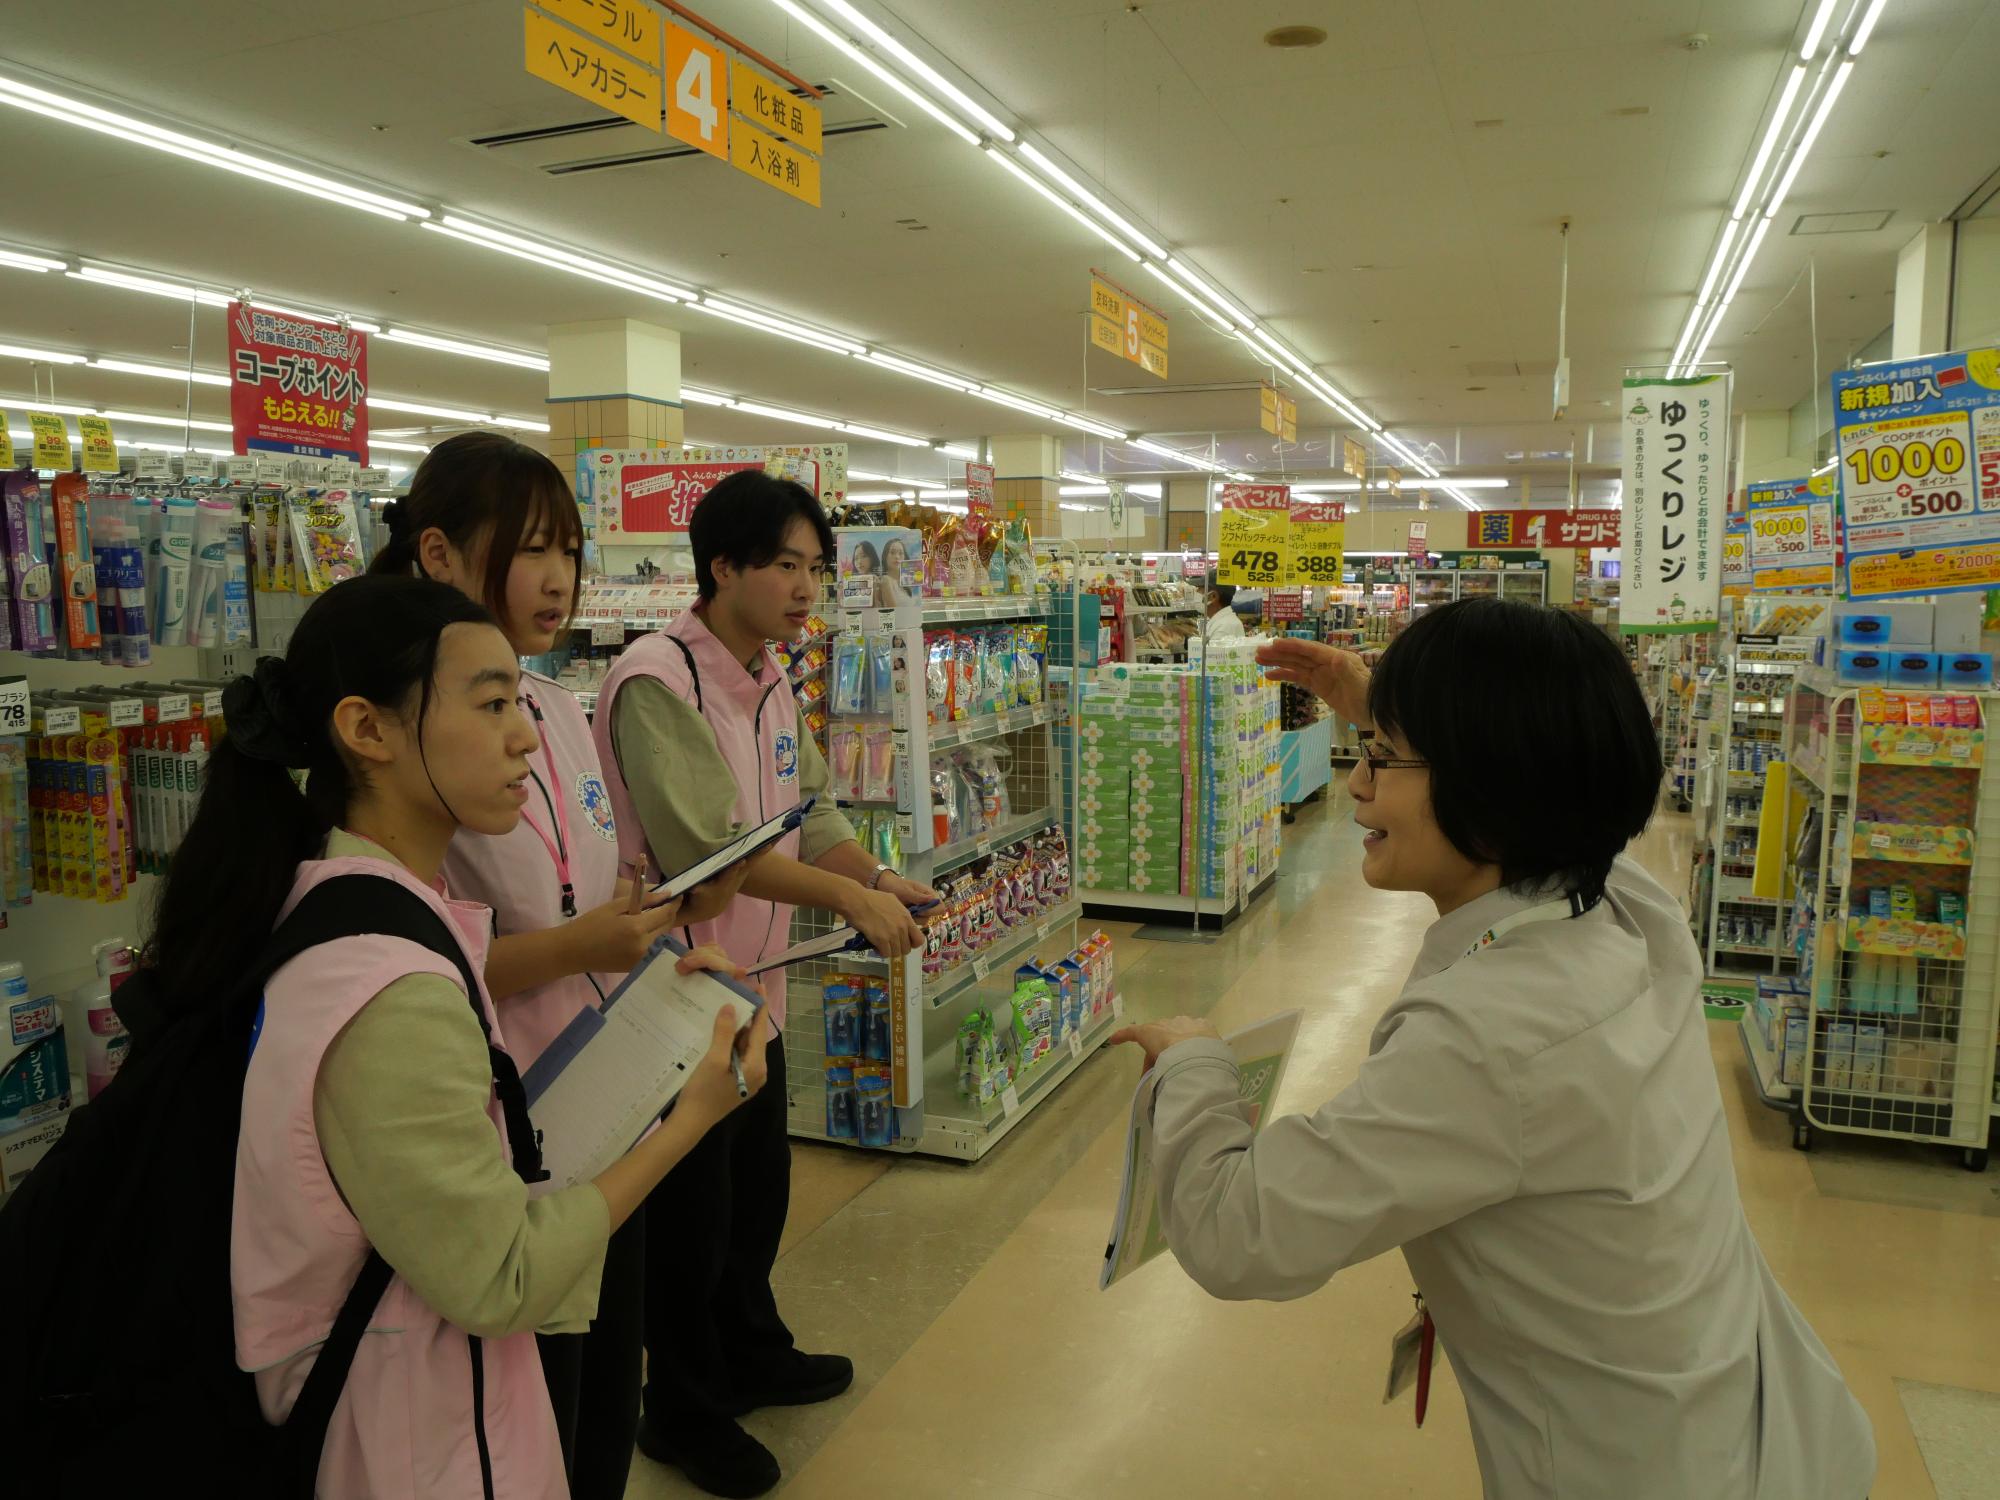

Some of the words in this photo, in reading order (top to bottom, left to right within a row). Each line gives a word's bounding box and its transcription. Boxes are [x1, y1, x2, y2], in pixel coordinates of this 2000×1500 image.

[556, 0, 643, 42] ーラル
[548, 40, 646, 100] ヘアカラー
[676, 47, 717, 141] 4
[753, 84, 804, 135] 化粧品
[750, 139, 800, 188] 入浴剤
[252, 312, 347, 345] 洗剤・シャンプーなどの
[1127, 308, 1138, 356] 5
[236, 350, 365, 405] コープポイント
[1840, 378, 1942, 412] 新規加入
[264, 396, 340, 429] もらえる!!
[46, 436, 61, 445] 99
[93, 438, 108, 448] 99
[1846, 437, 1965, 485] 1000
[1250, 489, 1289, 509] これ!
[1660, 400, 1687, 583] ゆっくりレジ
[1910, 490, 1962, 516] 500
[1309, 505, 1342, 521] これ!
[1754, 517, 1806, 538] 1000
[1483, 514, 1511, 544] 薬
[1231, 550, 1279, 572] 478
[1781, 541, 1804, 553] 500
[1247, 571, 1275, 583] 525
[1296, 556, 1337, 573] 388
[1310, 573, 1335, 582] 426
[8, 718, 26, 728] 415
[29, 1050, 45, 1102] システマ
